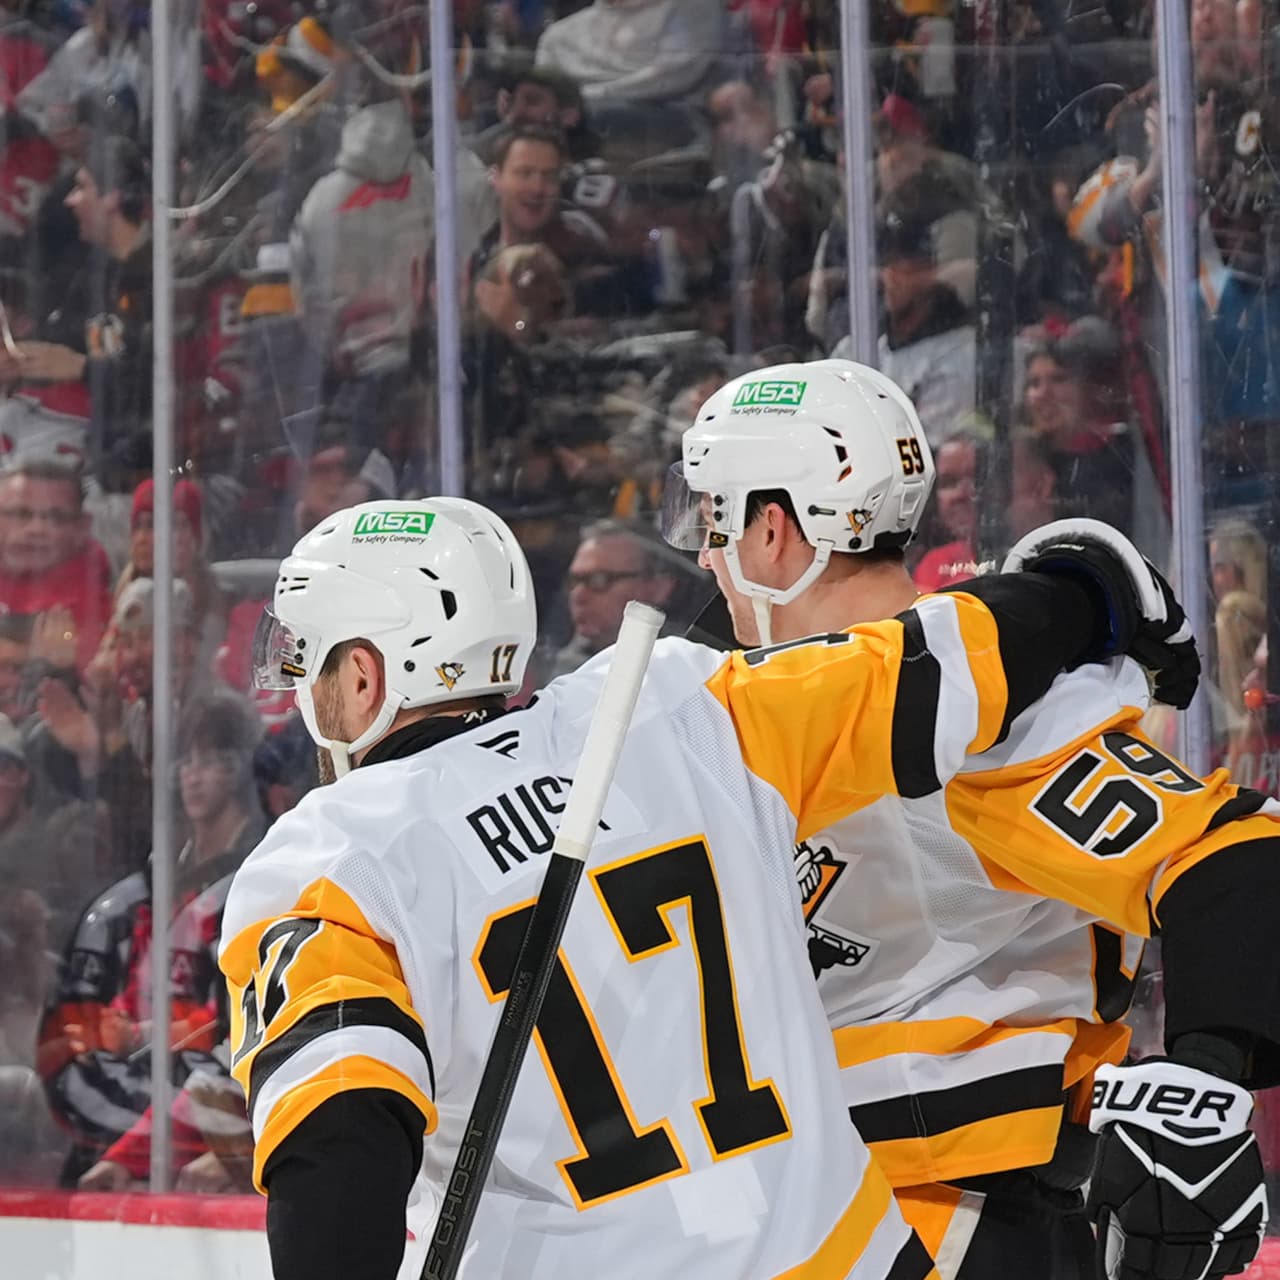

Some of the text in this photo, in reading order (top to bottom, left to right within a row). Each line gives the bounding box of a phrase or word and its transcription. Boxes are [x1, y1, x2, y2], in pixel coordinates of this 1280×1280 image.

[734, 381, 802, 405] MSA
[741, 405, 762, 416] Safety
[763, 406, 799, 417] Company
[895, 436, 925, 477] 59
[356, 512, 428, 532] MSA
[365, 533, 387, 545] Safety
[389, 533, 427, 545] Company
[489, 643, 520, 684] 17
[1029, 730, 1206, 861] 59
[465, 776, 611, 874] RUS
[232, 917, 324, 1066] 17
[472, 834, 793, 1212] 17
[436, 1117, 484, 1247] GHOST
